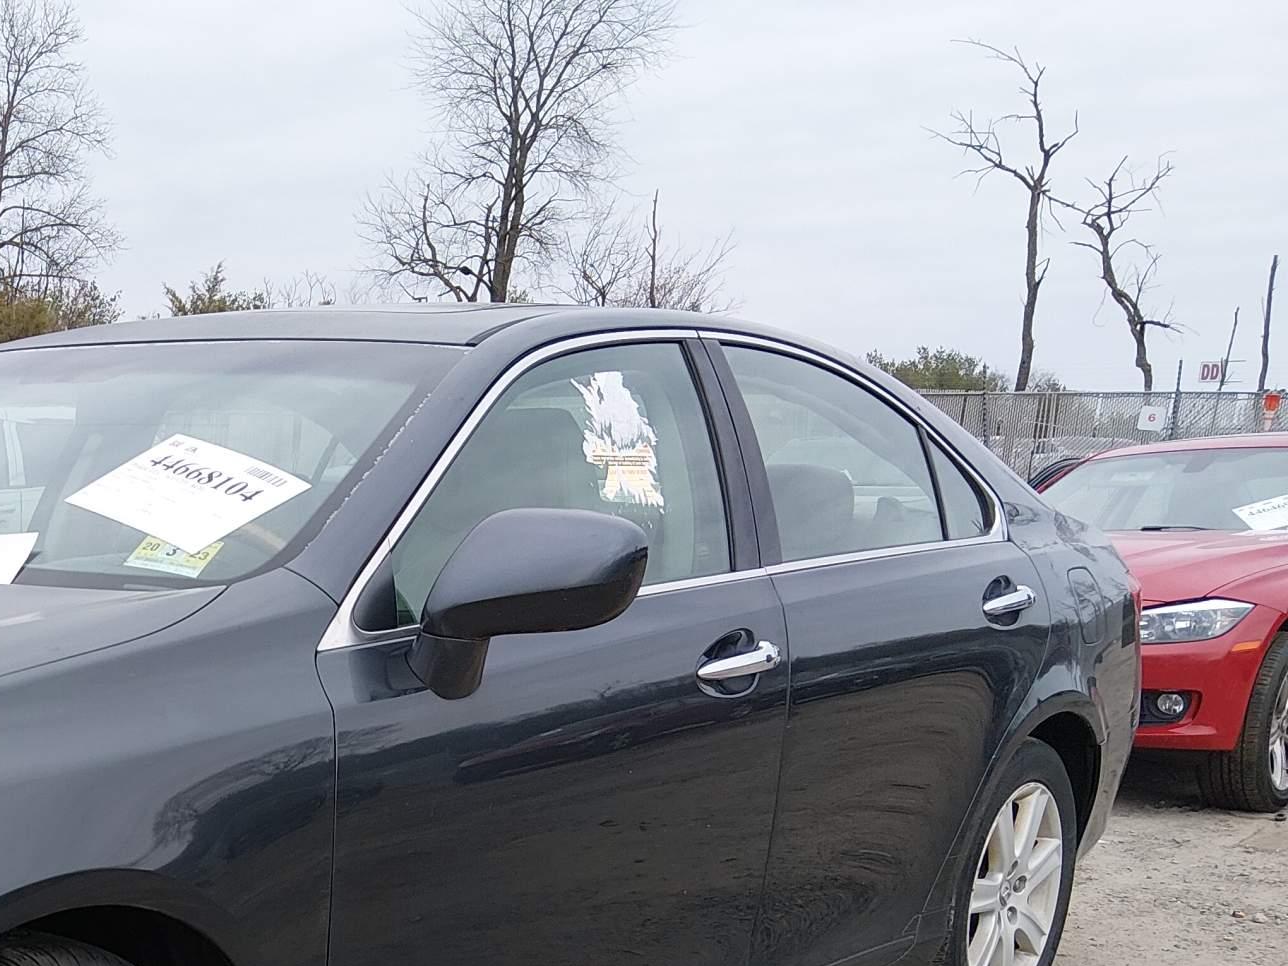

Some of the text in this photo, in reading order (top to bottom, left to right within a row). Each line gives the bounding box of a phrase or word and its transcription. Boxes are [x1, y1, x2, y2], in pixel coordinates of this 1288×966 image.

[1148, 413, 1157, 423] 6
[150, 454, 265, 502] 44668104
[142, 541, 161, 552] 20
